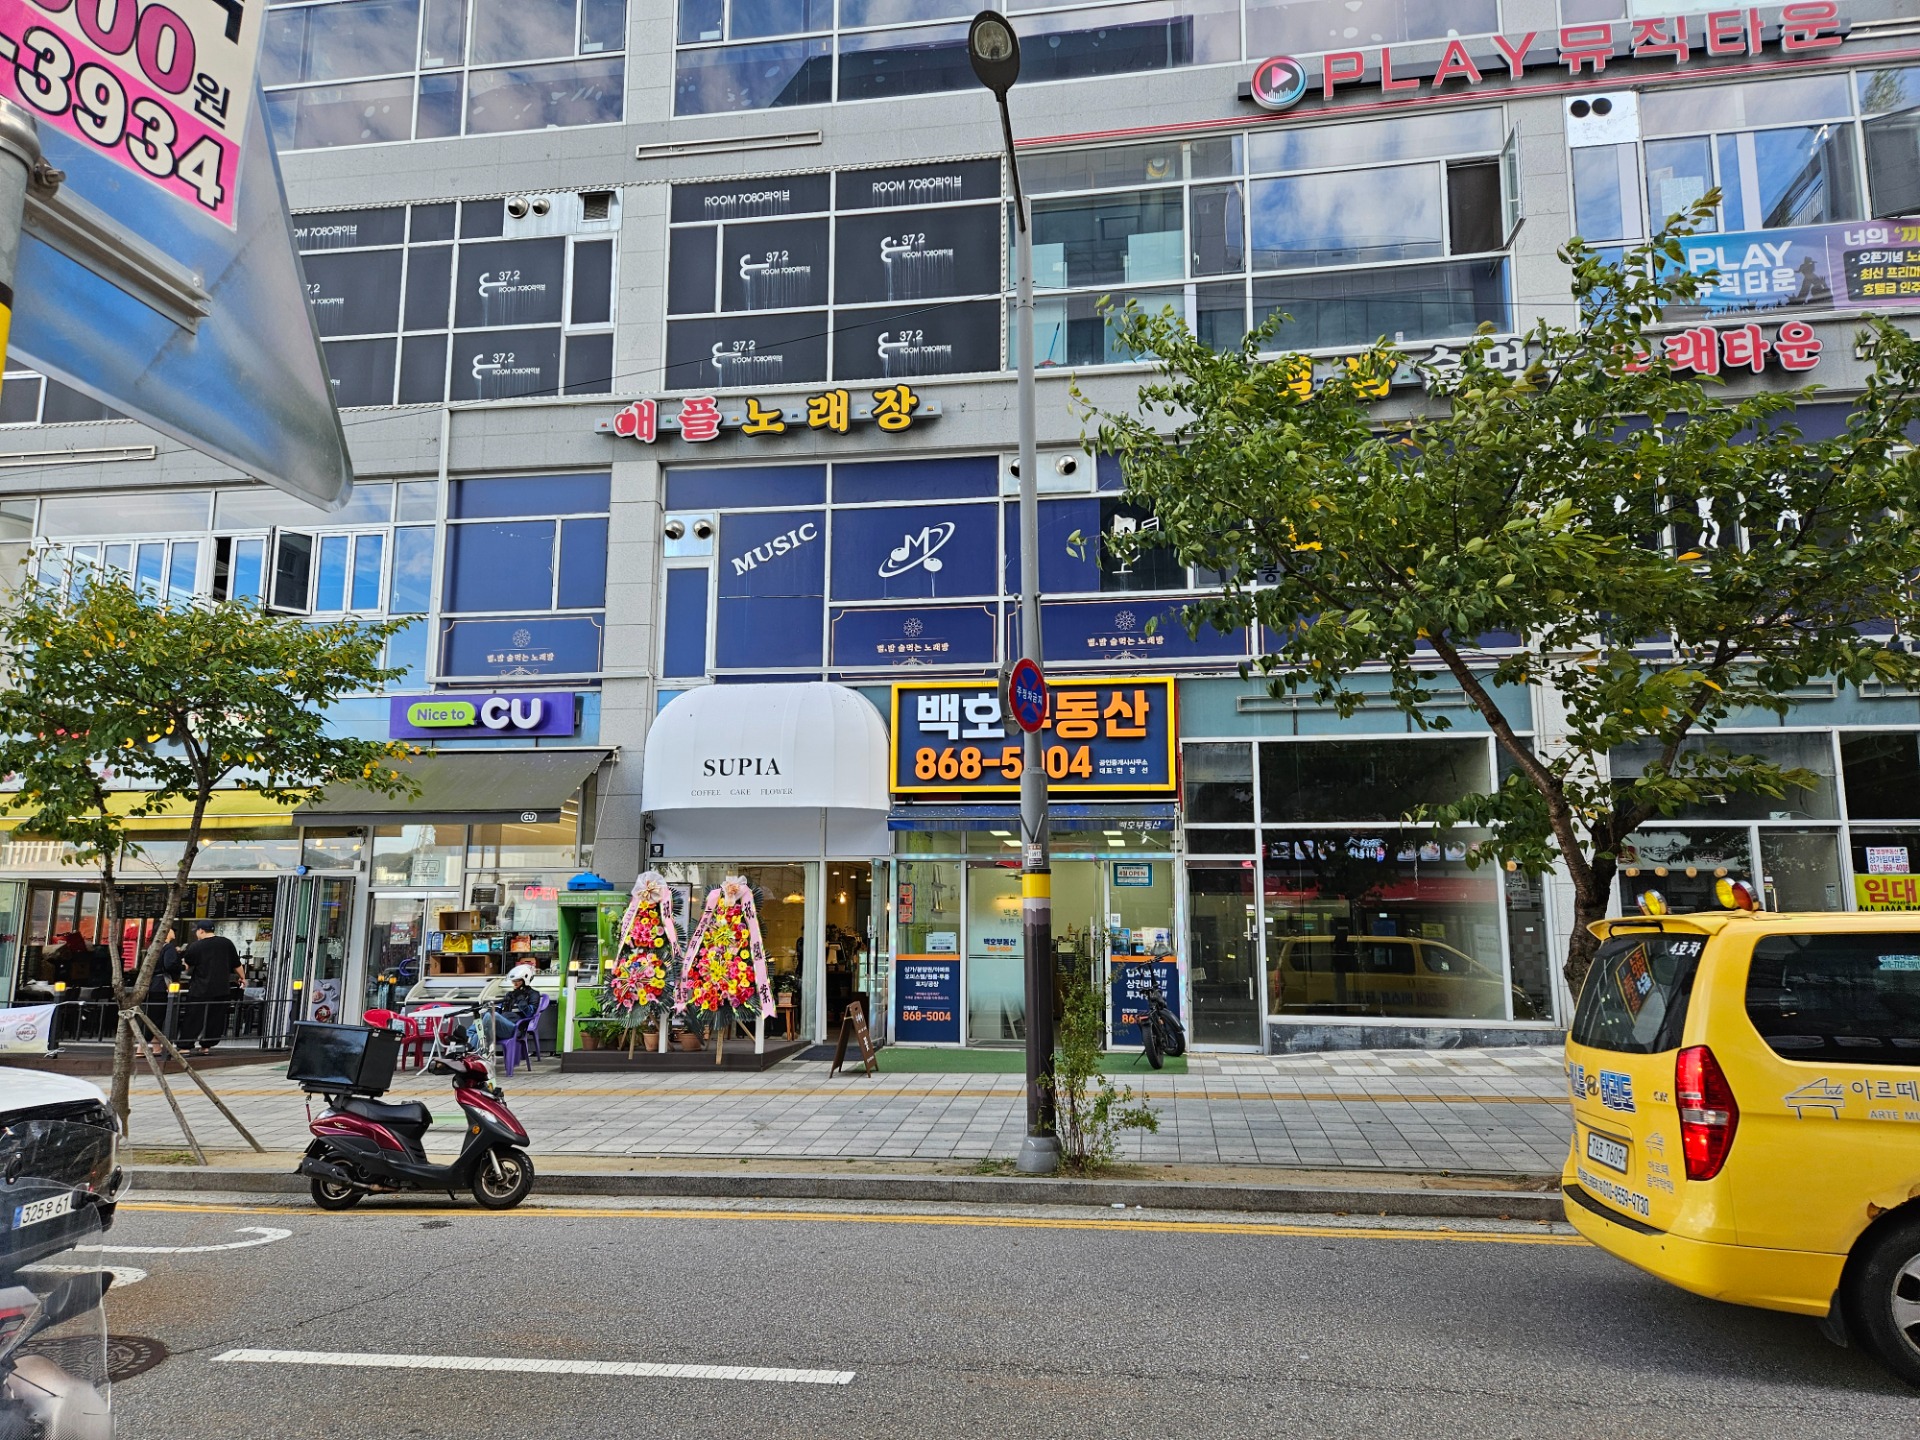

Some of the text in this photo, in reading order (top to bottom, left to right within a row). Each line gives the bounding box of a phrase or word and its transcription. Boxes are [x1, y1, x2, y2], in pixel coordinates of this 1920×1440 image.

[1323, 1, 1844, 101] PLAY 뮤직타운
[873, 176, 962, 193] ROOM 7080라이브
[705, 189, 790, 206] ROOM 7080라이브
[310, 225, 357, 236] 7080라이브
[1844, 228, 1889, 246] 너의
[902, 233, 926, 246] 37.2
[766, 250, 789, 263] 37.2
[1688, 240, 1793, 274] PLAY
[1859, 251, 1904, 264] 오픈기념
[498, 271, 521, 281] 37.2
[1860, 267, 1883, 280] 최신
[1863, 282, 1896, 296] 호텔급
[899, 330, 923, 343] 37.2
[732, 340, 756, 352] 37.2
[492, 353, 515, 364] 37.2
[731, 522, 818, 576] MUSIC
[1138, 634, 1165, 645] 노래방
[924, 642, 950, 652] 노래방
[1016, 685, 1043, 706] 주정차금지
[416, 697, 543, 730] Nice to CU
[703, 757, 782, 778] SUPIA
[914, 745, 1093, 781] 868-504
[691, 788, 794, 797] COFFEE CAKE FLOWER
[1119, 821, 1161, 830] 백호부동산
[524, 886, 559, 900] OPEN
[1864, 878, 1918, 903] 임대
[899, 884, 913, 923] OPEN
[983, 938, 1017, 946] 백호부동산
[1669, 942, 1701, 957] 4호차
[903, 1011, 951, 1021] 868-5004
[1852, 1080, 1920, 1102] 아르떼
[1870, 1110, 1899, 1120] ARTE
[22, 1203, 54, 1224] 325우
